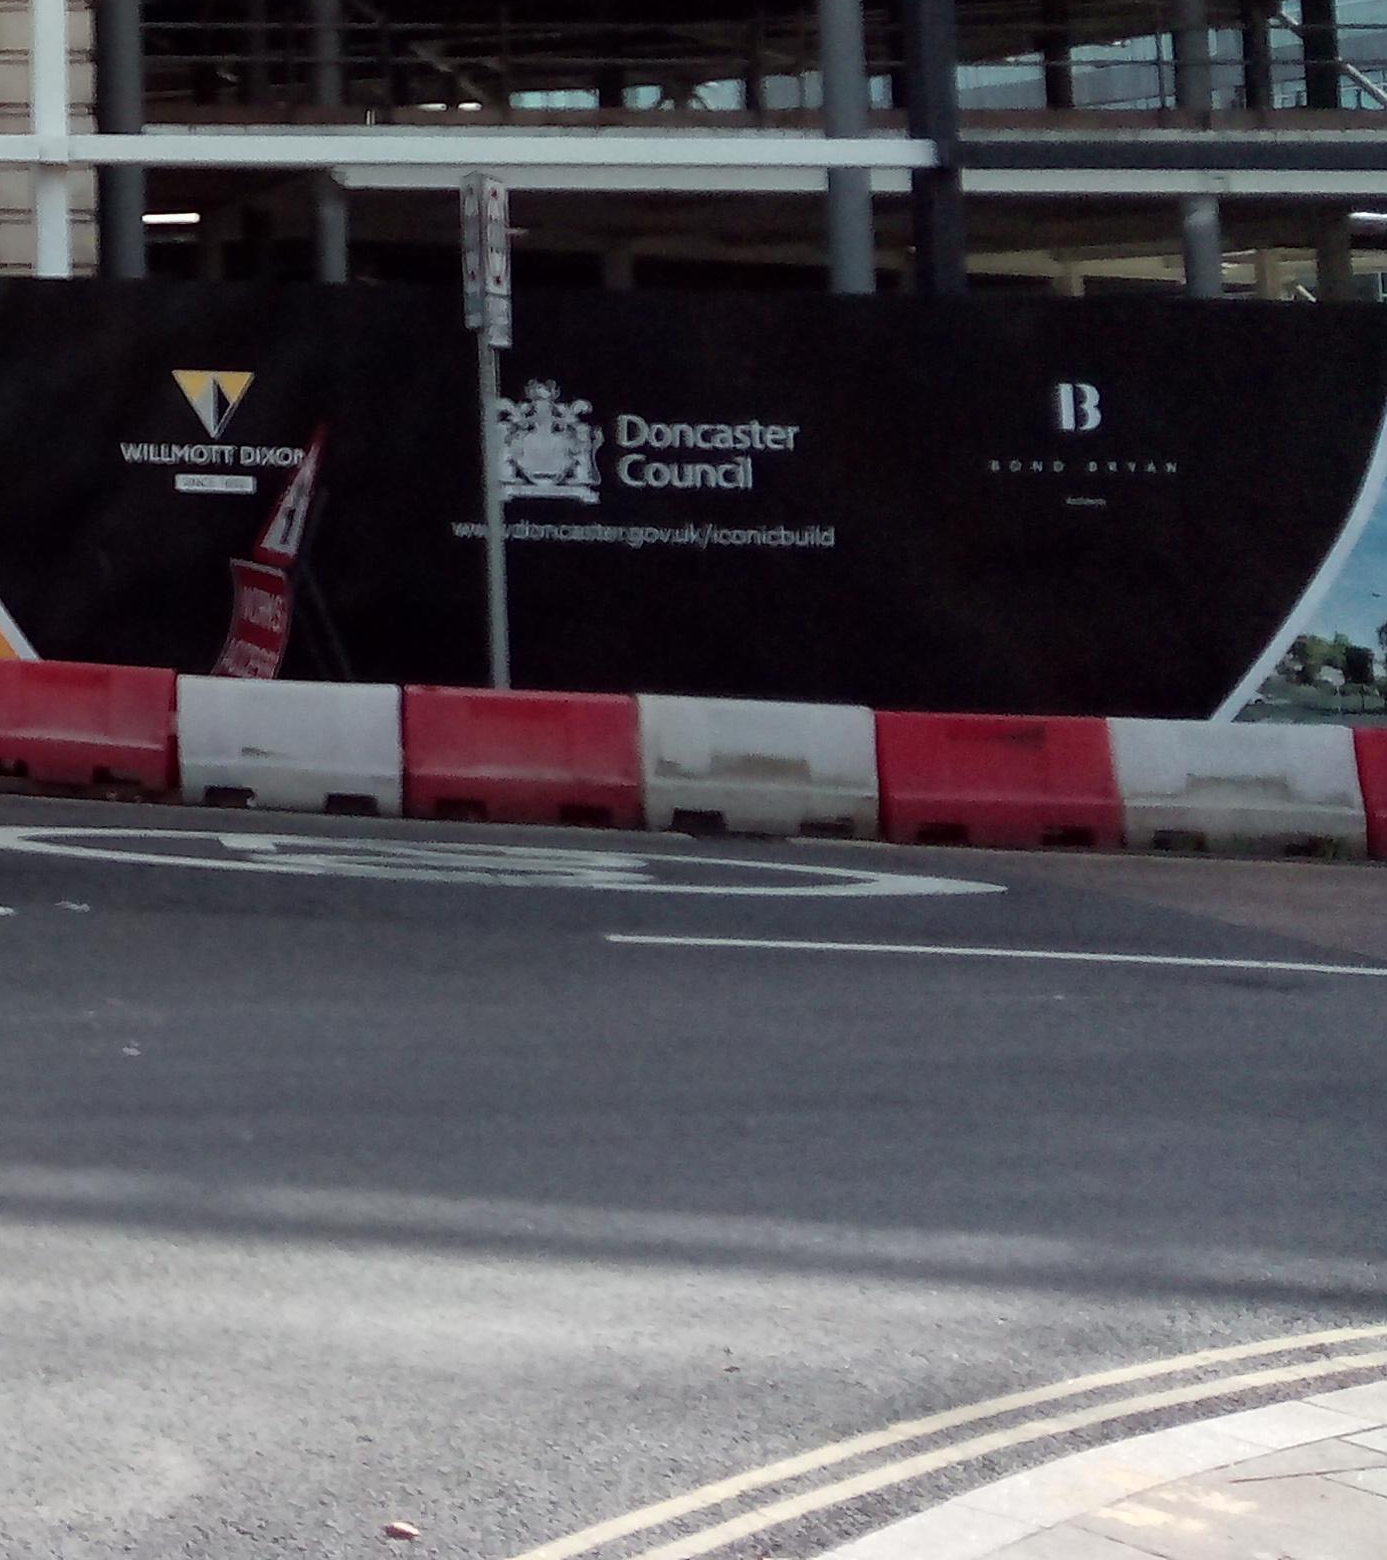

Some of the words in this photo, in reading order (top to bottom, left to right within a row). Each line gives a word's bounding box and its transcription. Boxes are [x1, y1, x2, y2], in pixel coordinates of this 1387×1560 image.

[1055, 383, 1102, 431] B
[616, 414, 799, 451] Doncaster
[120, 443, 238, 465] WILLMOTT
[618, 454, 753, 489] Council
[989, 459, 1065, 473] BOND
[1088, 460, 1177, 474] BRYAN
